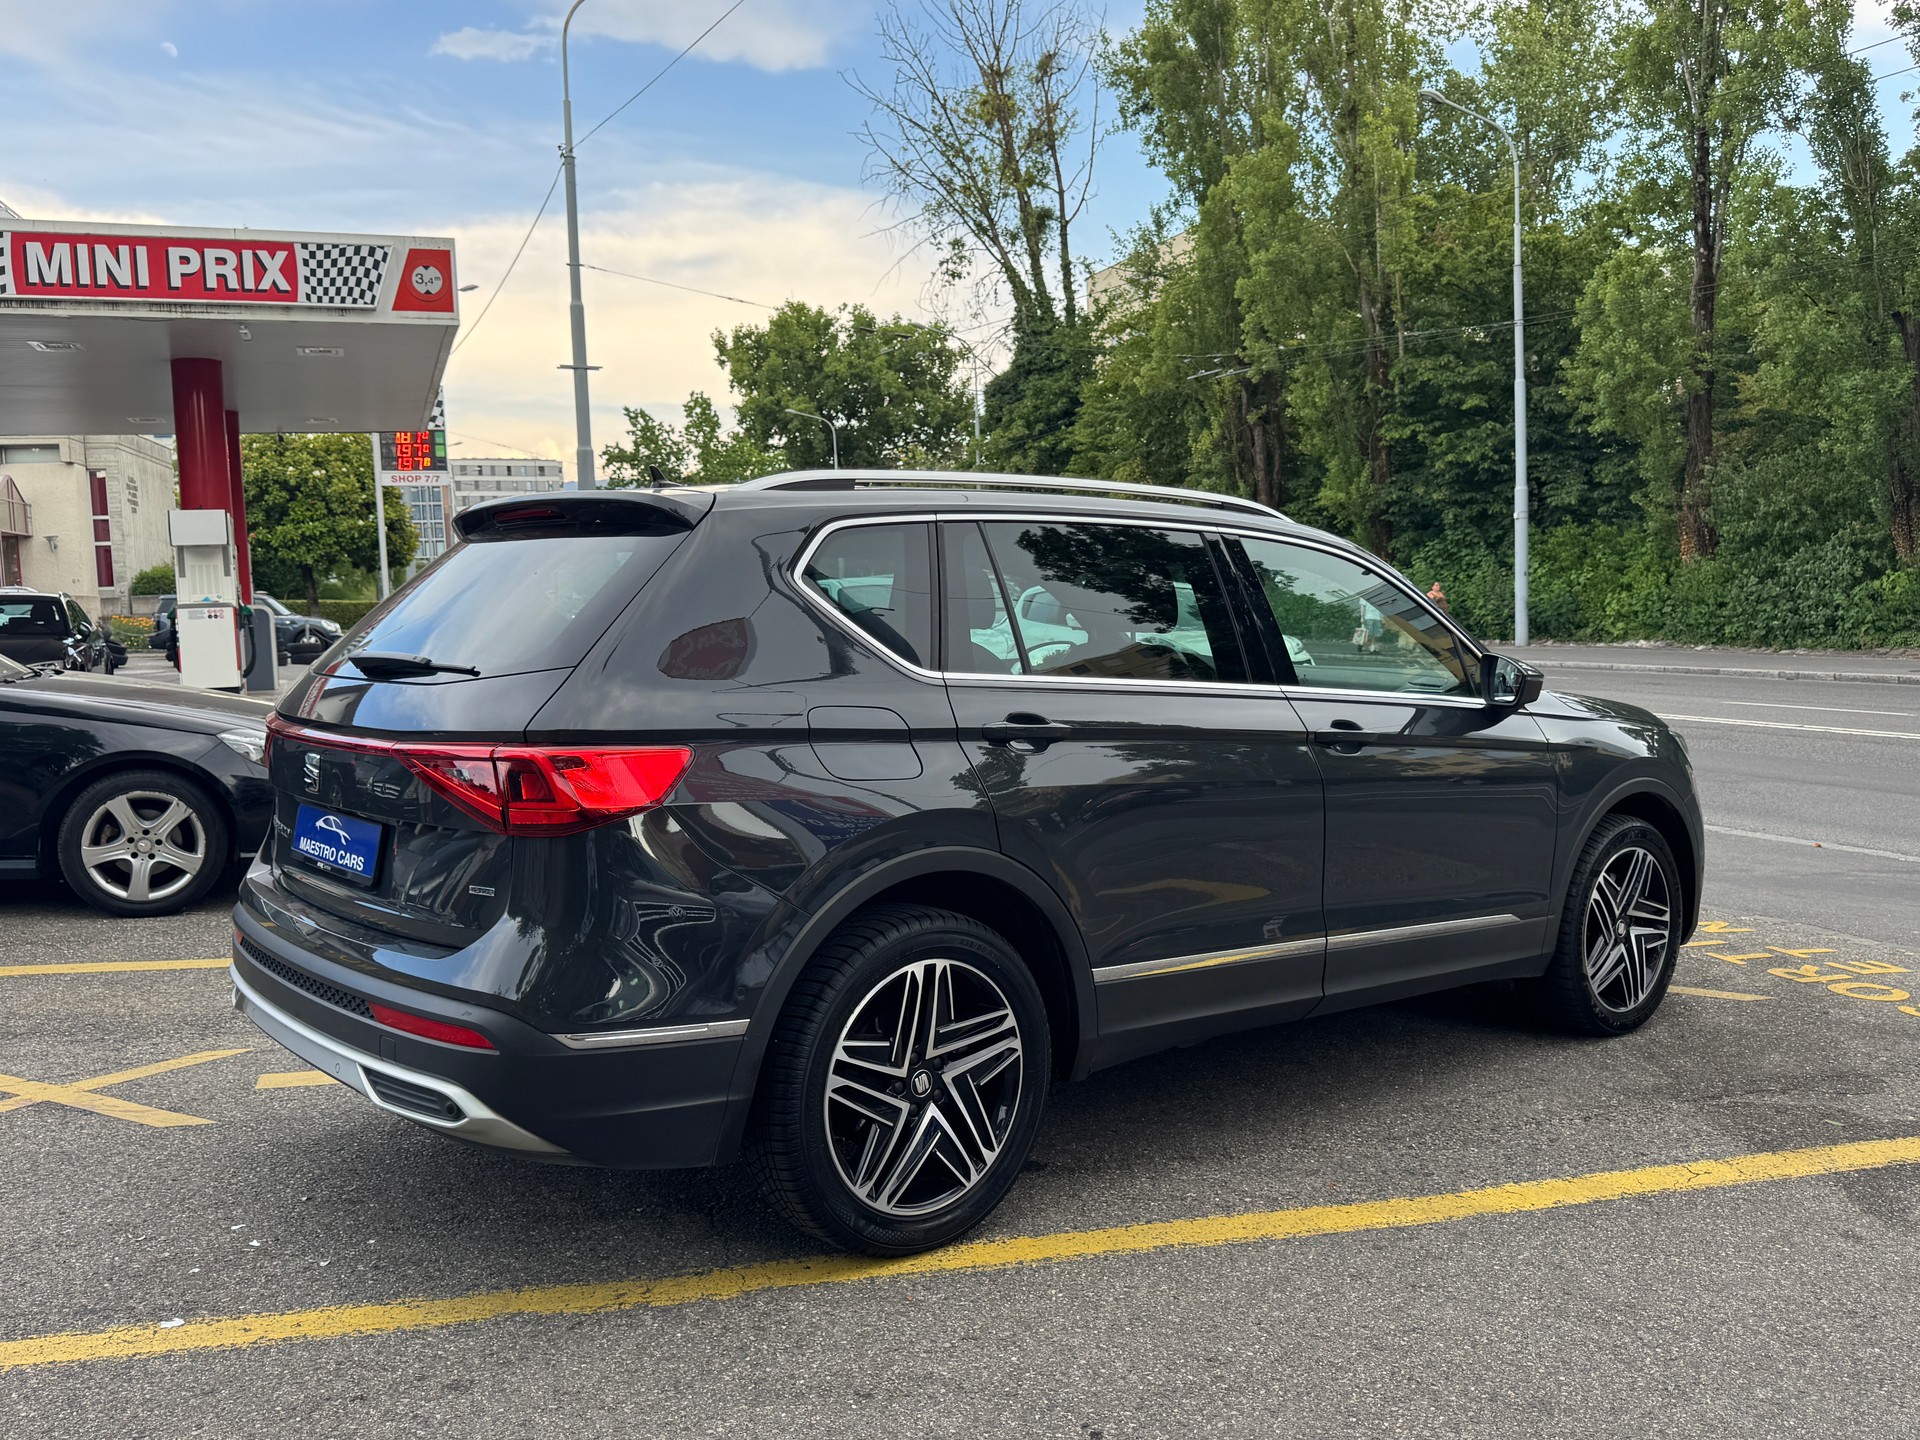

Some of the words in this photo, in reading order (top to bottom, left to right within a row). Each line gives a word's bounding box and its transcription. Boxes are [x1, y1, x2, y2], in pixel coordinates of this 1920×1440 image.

[24, 241, 150, 288] MINI
[167, 246, 292, 292] PRIX
[391, 475, 421, 483] SHOP
[424, 475, 441, 484] 7/7
[299, 836, 336, 861] MAESTRO
[337, 850, 364, 871] CARS
